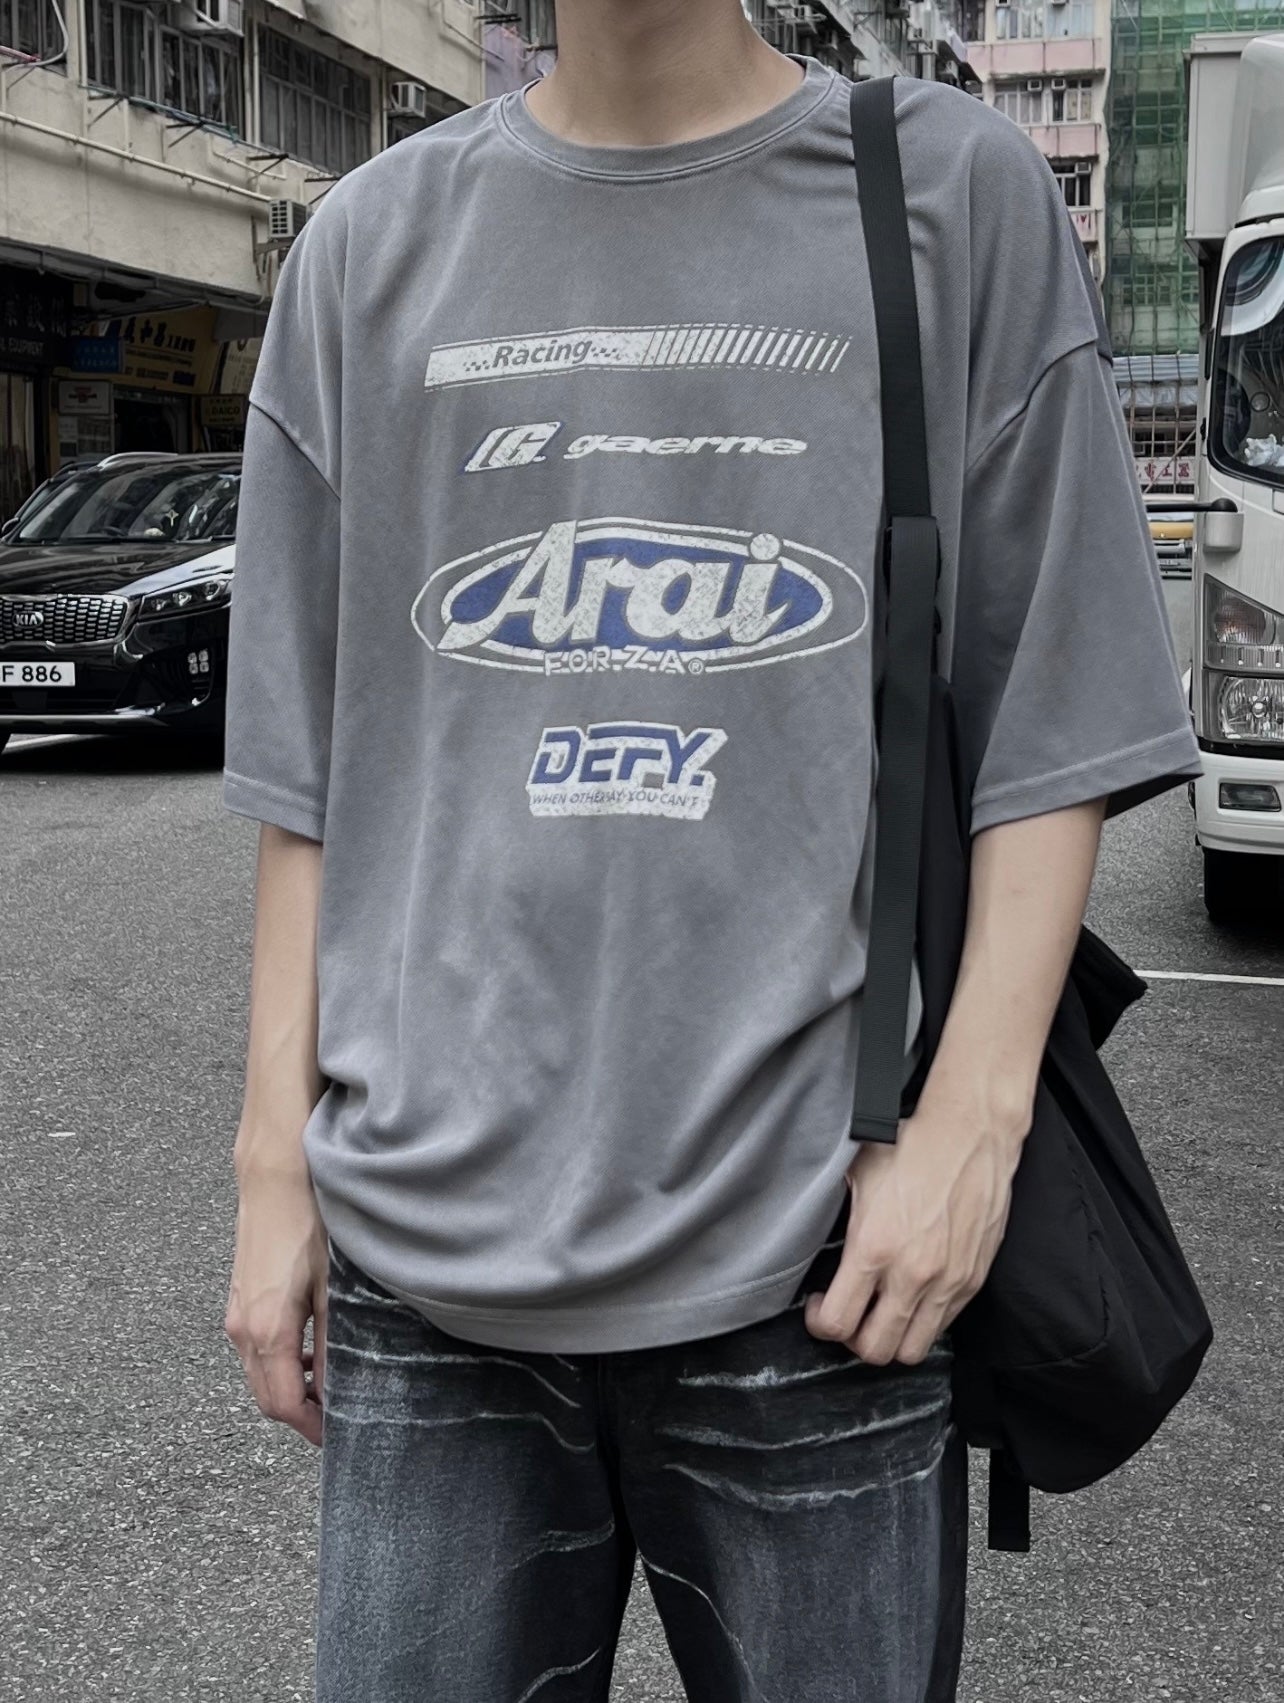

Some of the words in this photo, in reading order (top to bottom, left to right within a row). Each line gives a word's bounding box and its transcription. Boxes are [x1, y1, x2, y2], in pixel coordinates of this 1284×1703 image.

[492, 339, 593, 369] Racing
[563, 433, 808, 460] gaerne
[436, 519, 792, 650] Arai
[15, 614, 38, 625] KIA
[2, 664, 15, 682] F
[22, 664, 62, 683] 886
[532, 792, 568, 805] WHEN
[627, 789, 660, 802] YOU
